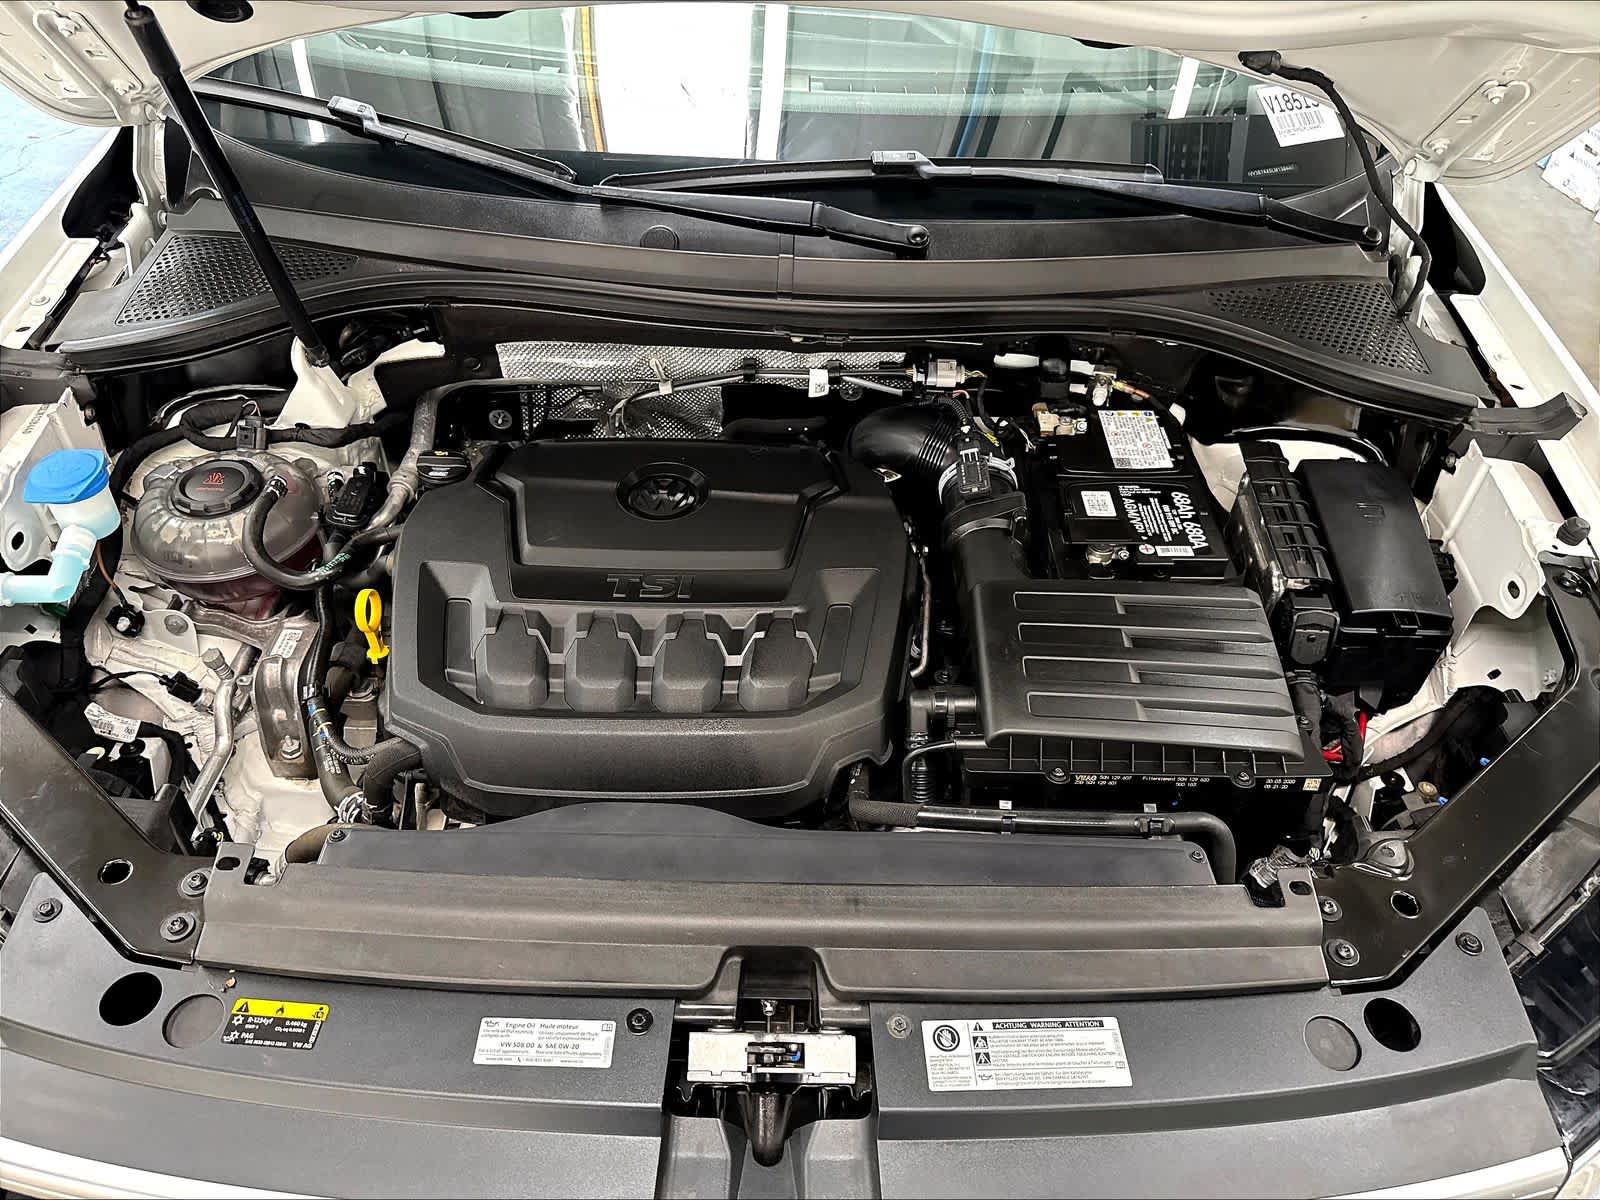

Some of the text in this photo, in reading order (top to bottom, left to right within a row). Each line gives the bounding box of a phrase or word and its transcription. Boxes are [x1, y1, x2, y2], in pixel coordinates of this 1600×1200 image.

[1171, 491, 1196, 519] 68Ah
[1182, 521, 1209, 550] 680A
[606, 574, 696, 599] TSI
[505, 1022, 526, 1030] Engine
